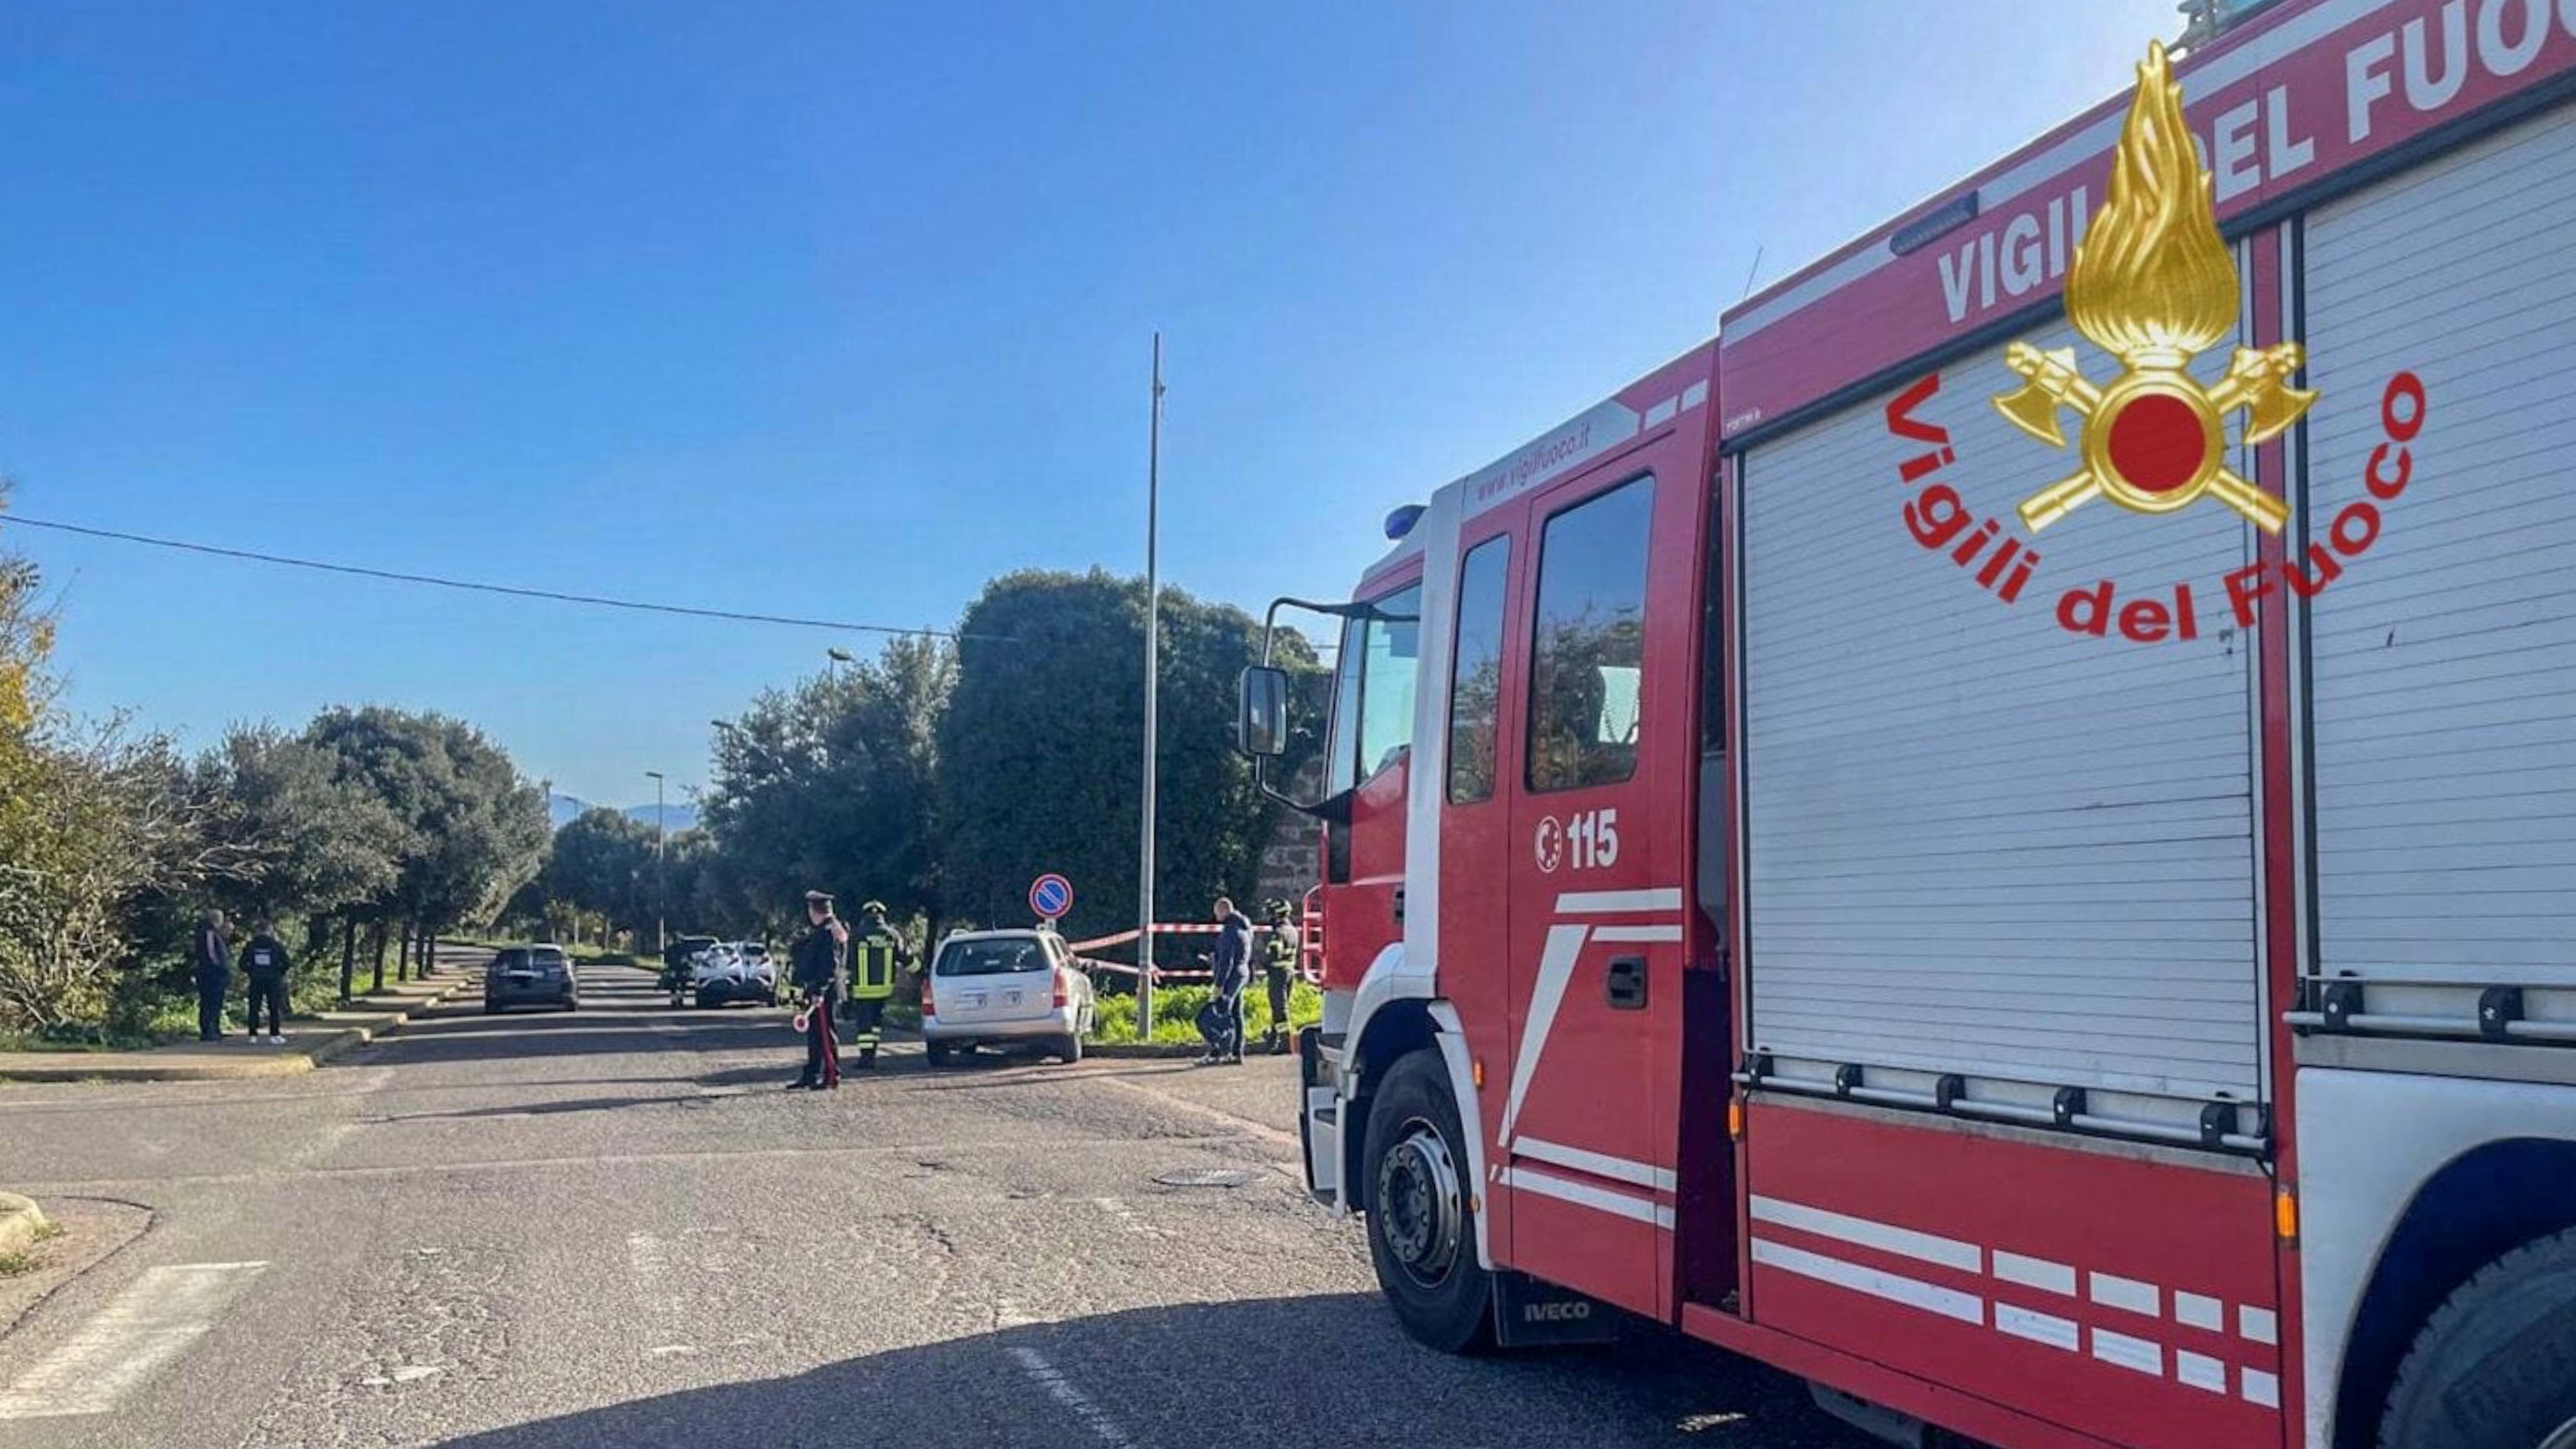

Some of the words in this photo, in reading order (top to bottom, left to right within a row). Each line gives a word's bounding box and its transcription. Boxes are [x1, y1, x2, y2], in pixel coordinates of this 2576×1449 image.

[2346, 0, 2576, 145] FUO
[1566, 808, 1619, 870] 115
[1524, 1301, 1591, 1322] IVECO
